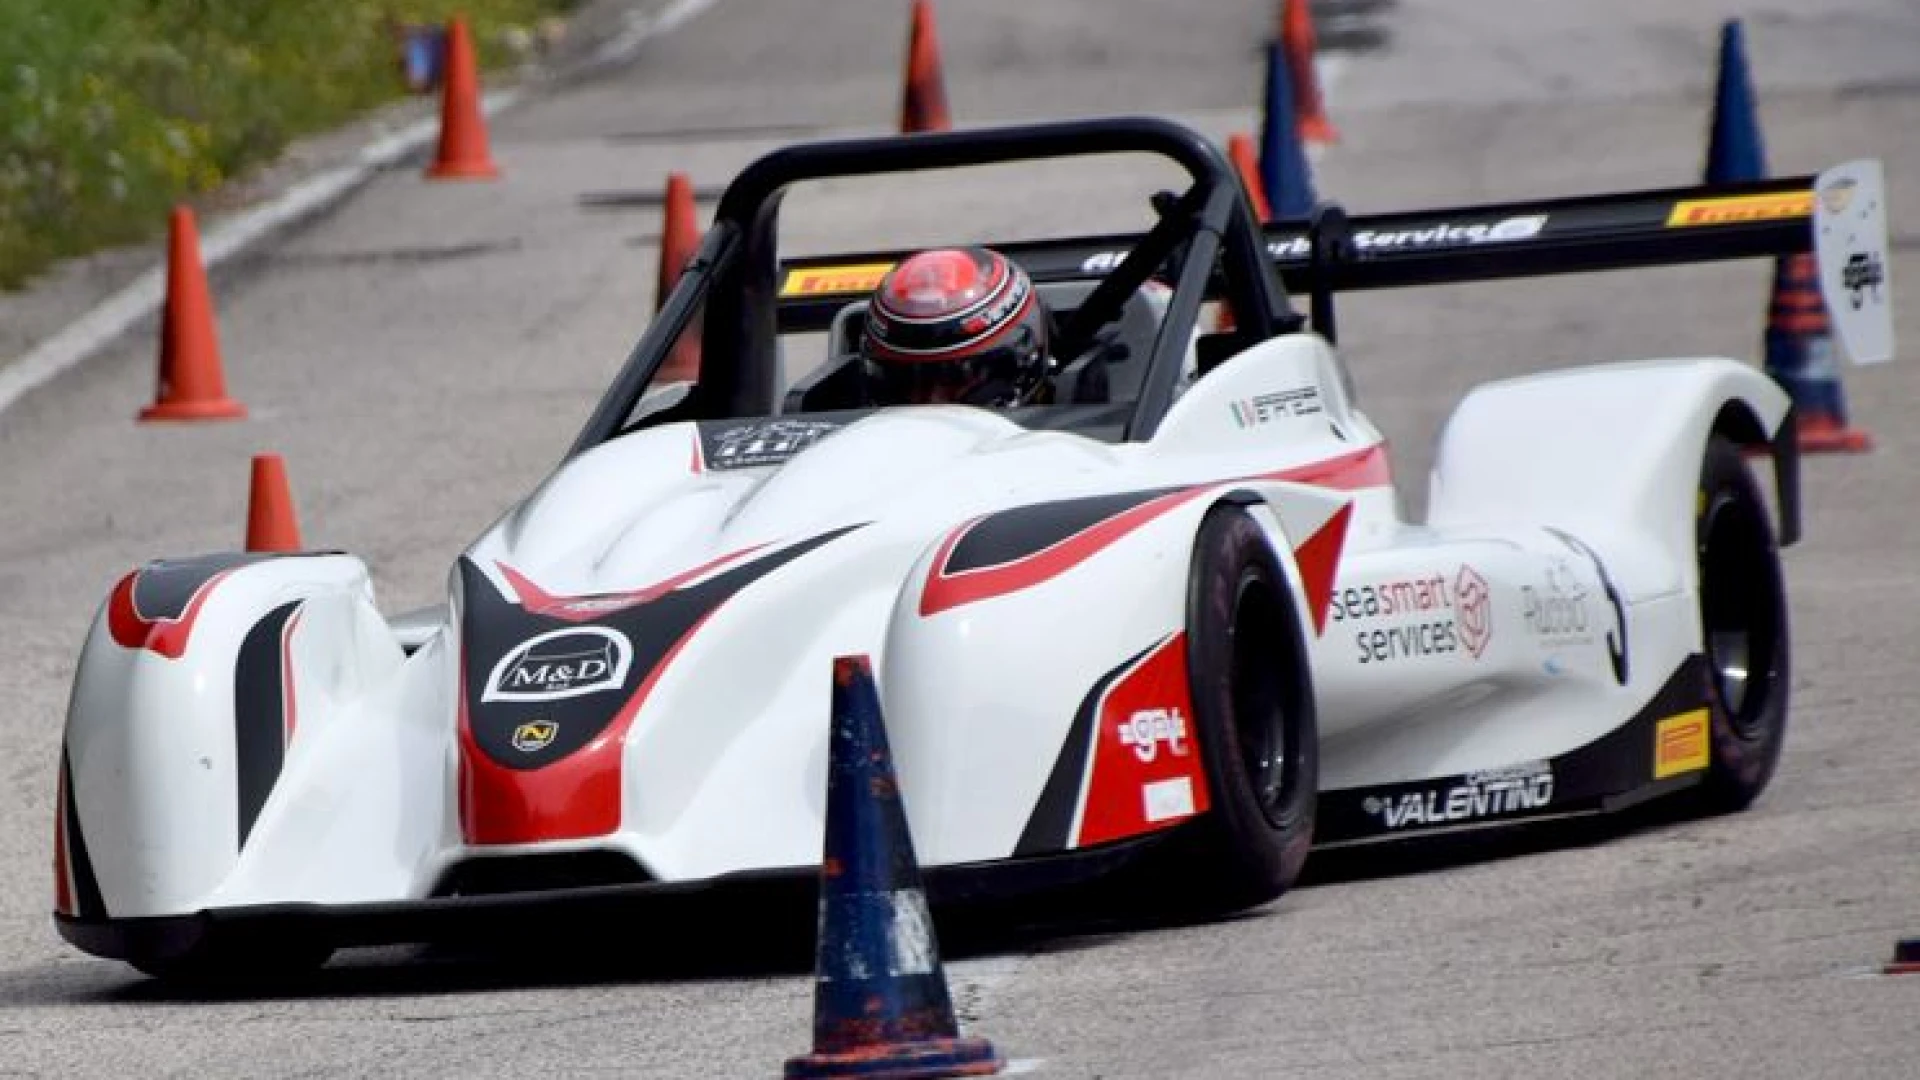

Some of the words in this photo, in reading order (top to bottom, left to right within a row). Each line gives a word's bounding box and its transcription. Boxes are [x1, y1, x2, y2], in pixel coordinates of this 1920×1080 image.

[1331, 574, 1451, 621] seasmart
[1357, 621, 1457, 664] services
[511, 659, 607, 688] M&D
[1383, 774, 1554, 829] VALENTINO
